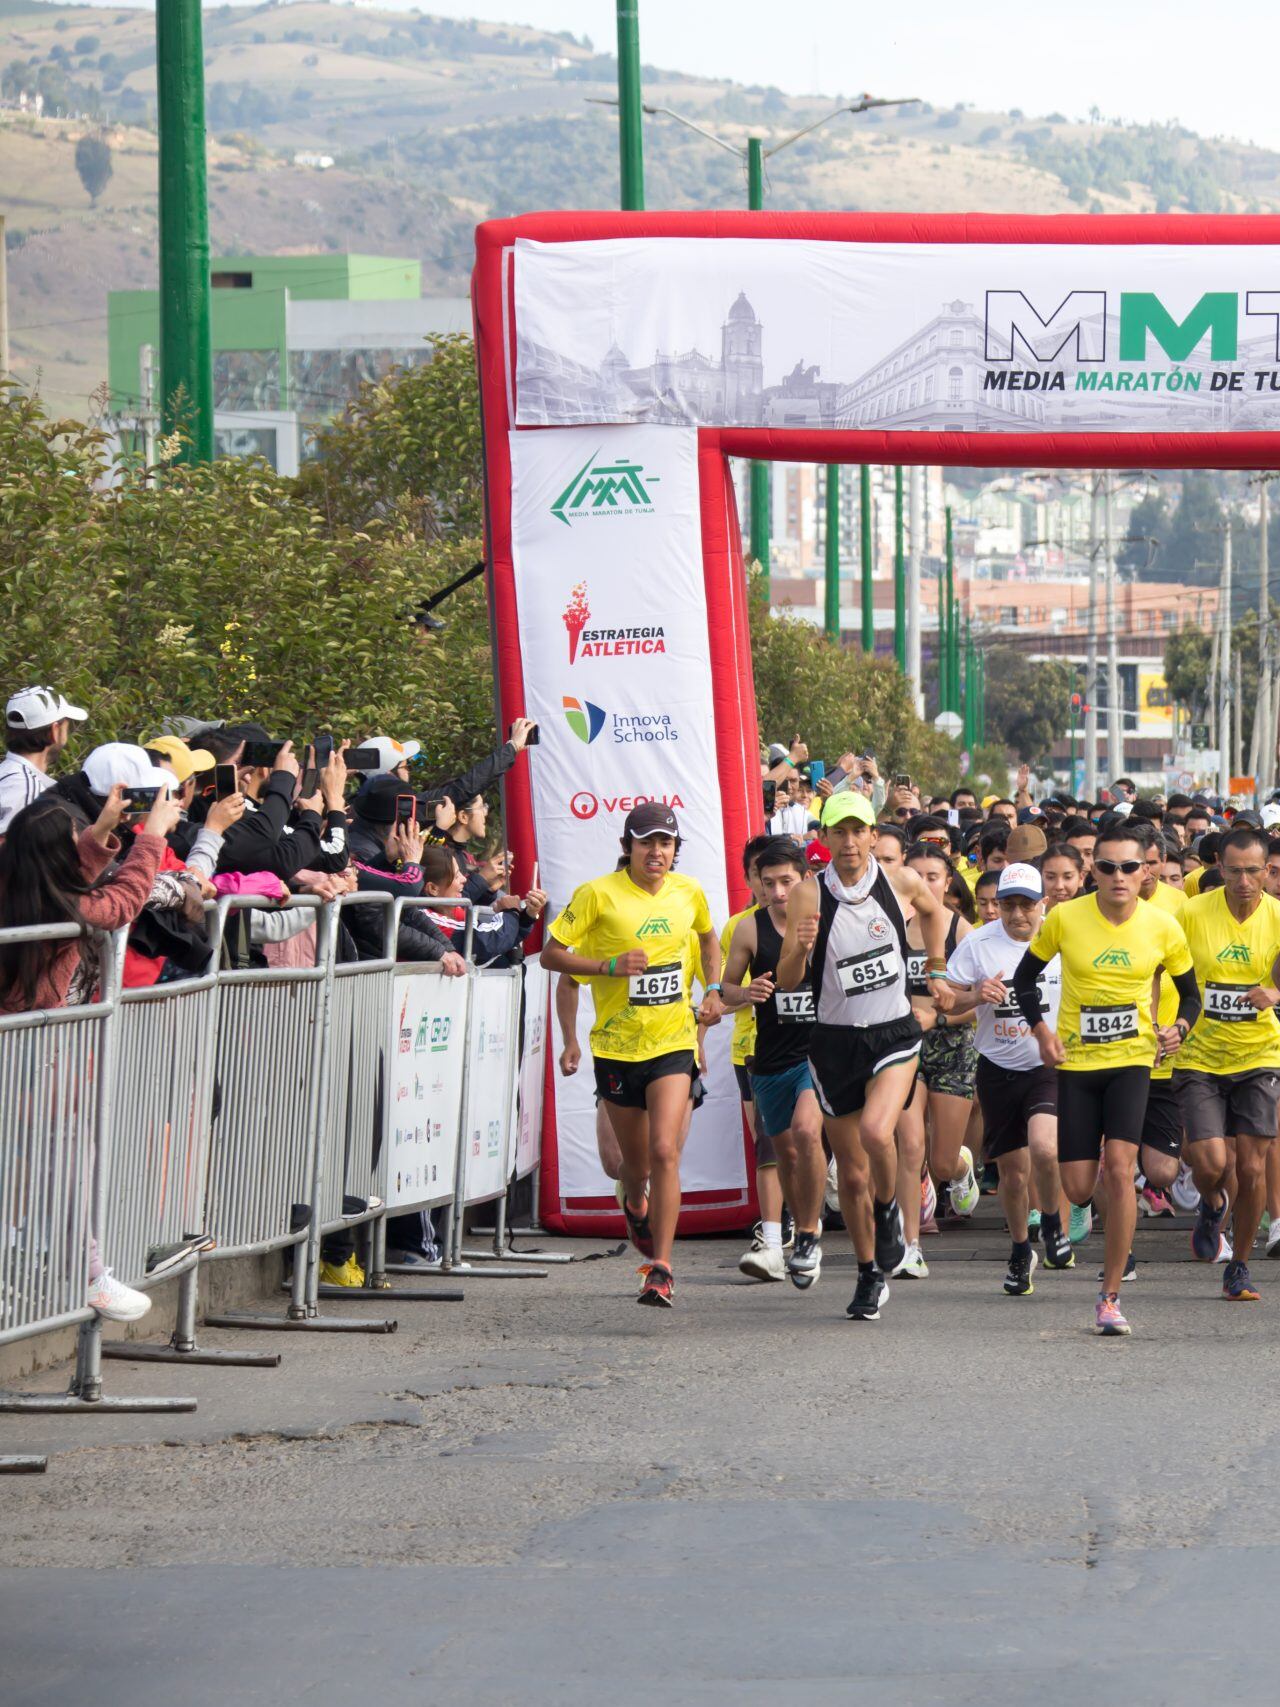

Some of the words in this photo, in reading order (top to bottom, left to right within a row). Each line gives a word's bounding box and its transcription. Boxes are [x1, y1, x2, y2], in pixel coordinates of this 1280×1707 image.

[983, 370, 1066, 391] MEDIA
[1074, 366, 1202, 392] MARATÓN
[1210, 371, 1243, 391] DE
[582, 627, 665, 641] ESTRATEGIA
[581, 638, 666, 657] ATLÉTICA
[613, 713, 671, 728] Innova
[614, 725, 678, 743] Schools
[852, 959, 890, 984] 651
[636, 974, 679, 995] 1675
[1087, 1014, 1133, 1034] 1842
